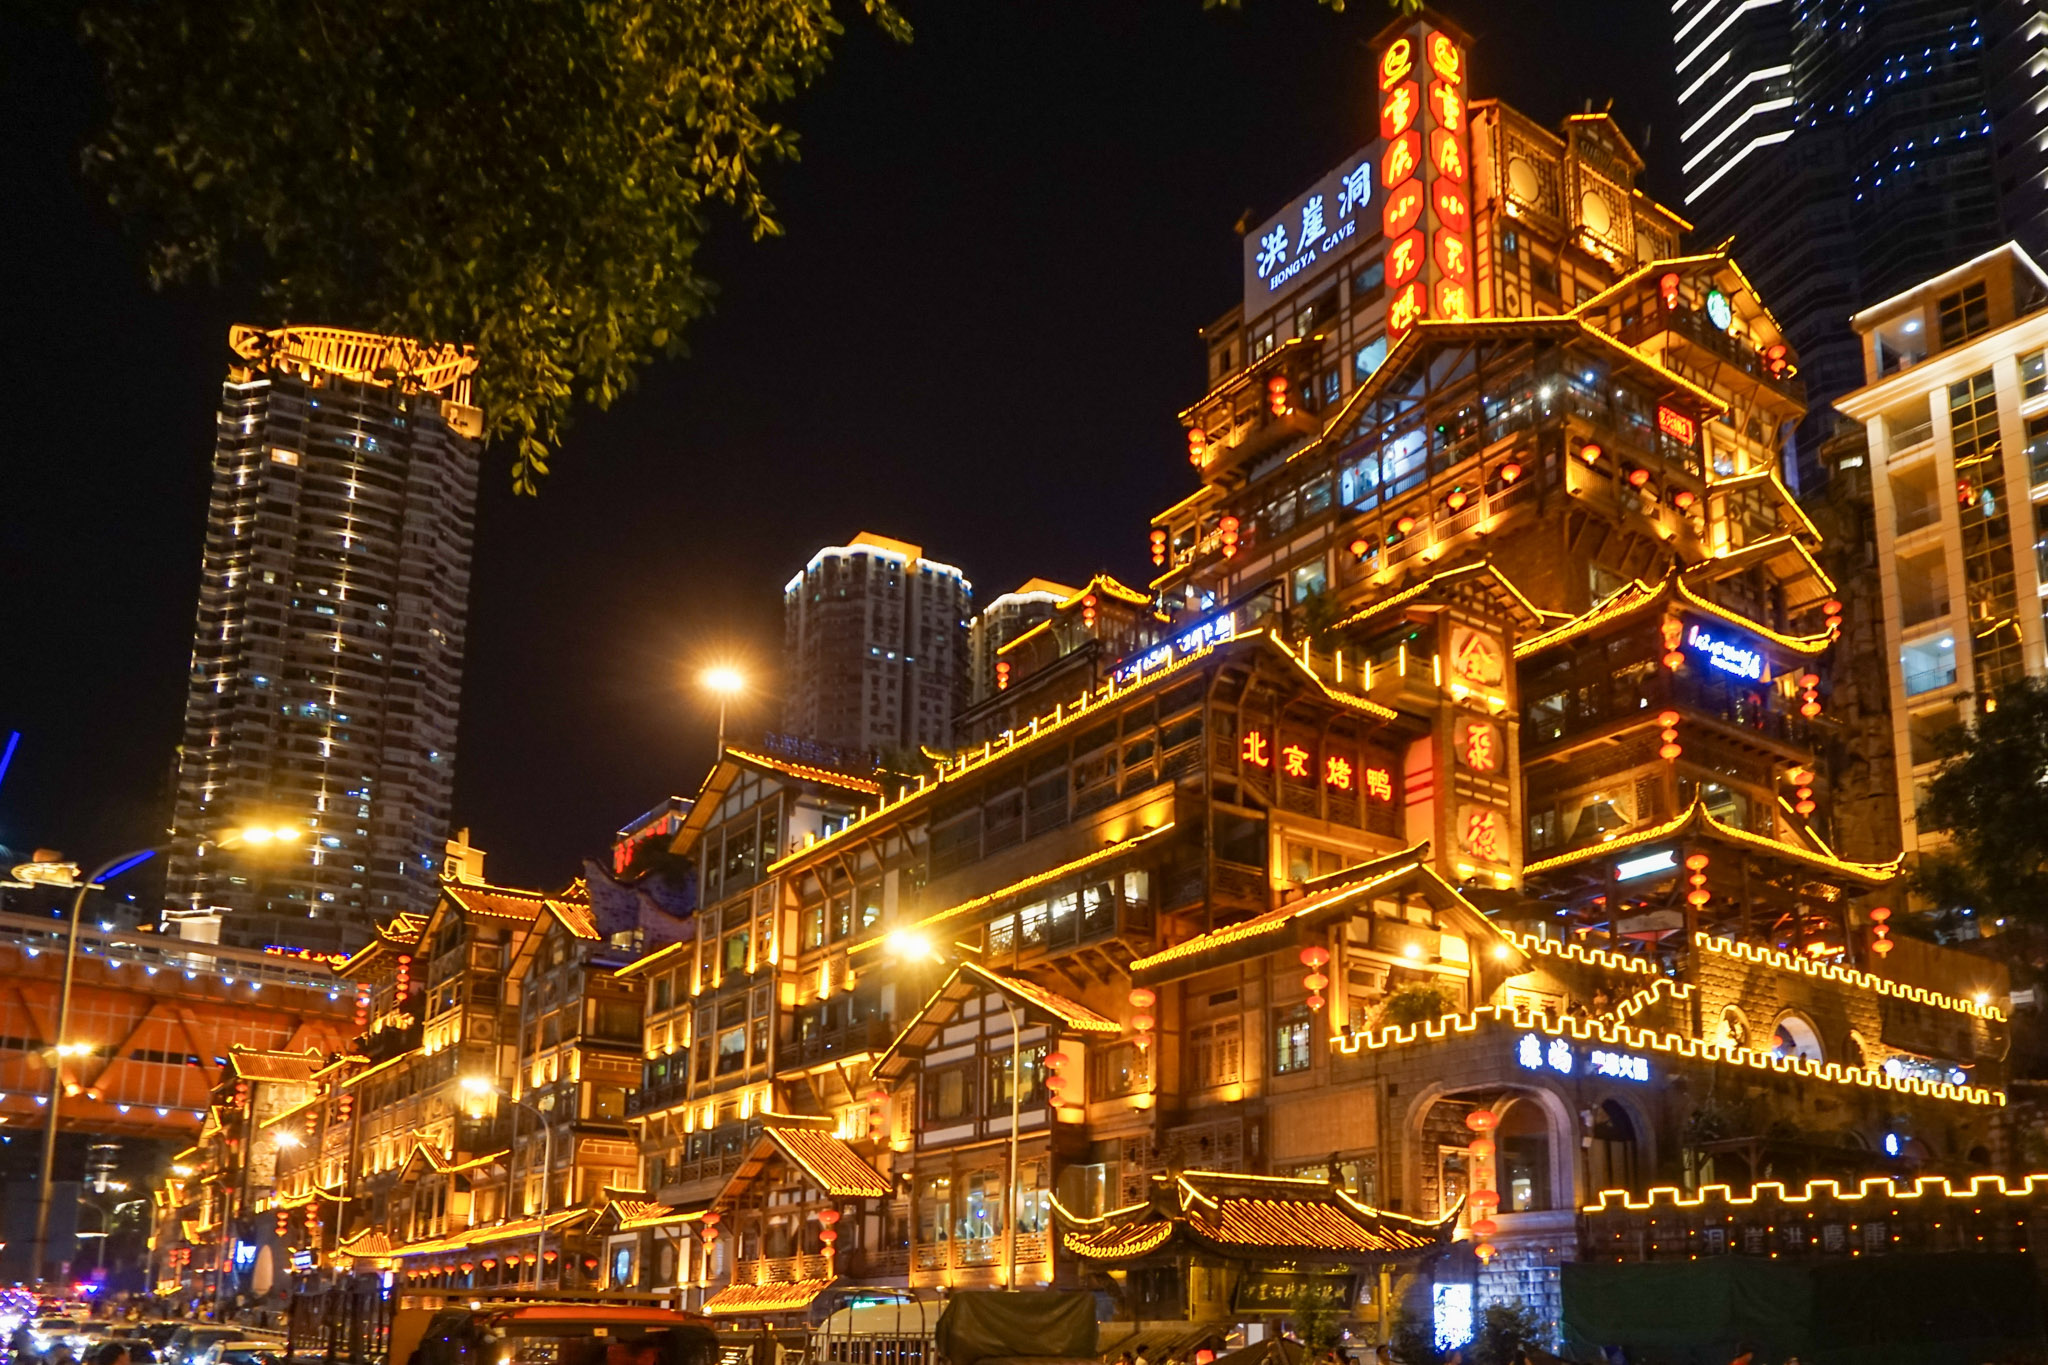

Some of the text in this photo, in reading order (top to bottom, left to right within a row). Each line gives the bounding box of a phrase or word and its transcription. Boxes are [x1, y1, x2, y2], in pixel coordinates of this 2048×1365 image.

[1255, 161, 1371, 279] 洪崖洞
[1269, 219, 1356, 291] HONGYA CAVE
[1241, 731, 1393, 802] 北京烤鸭
